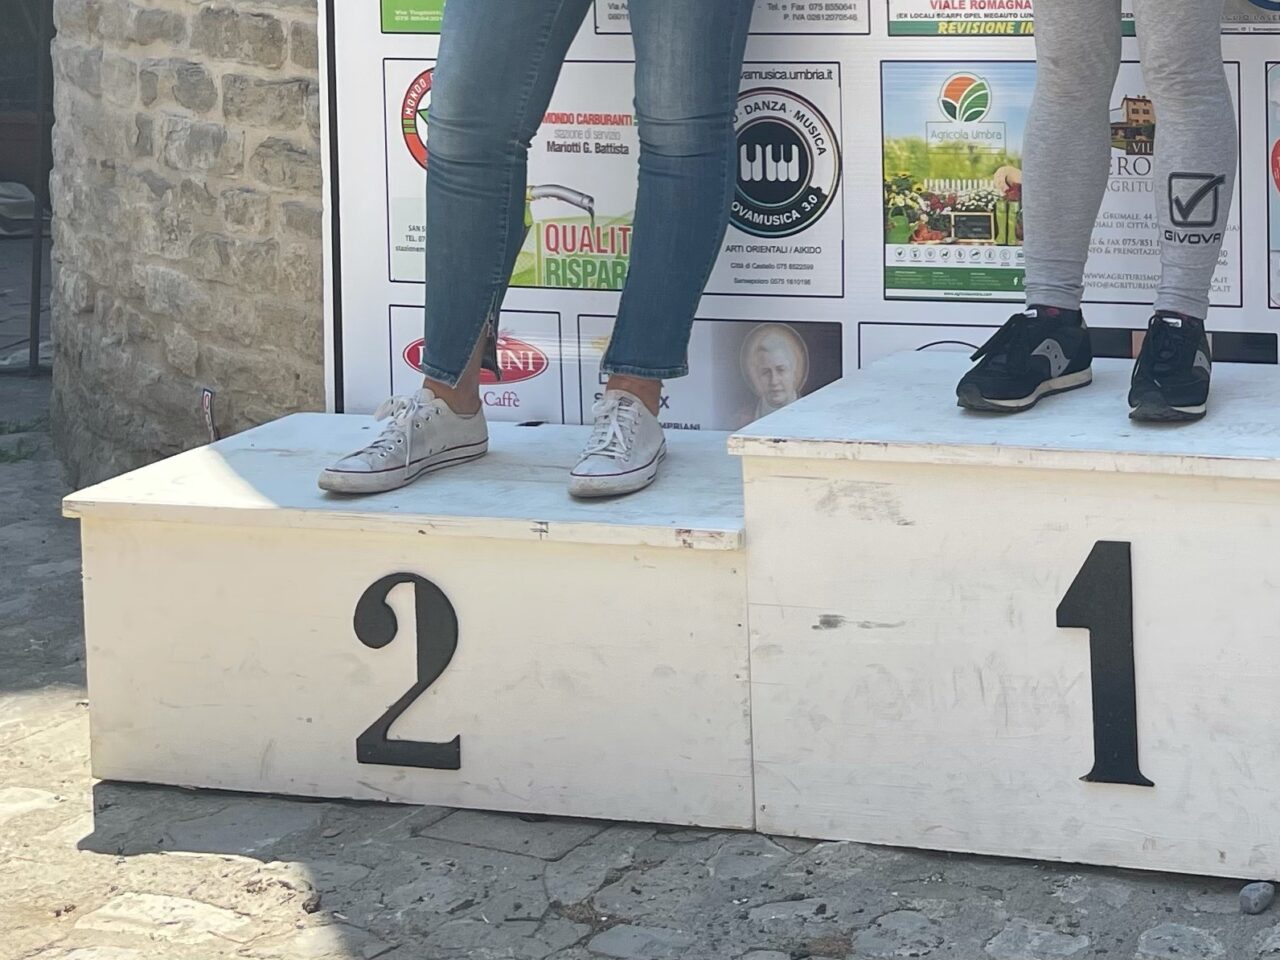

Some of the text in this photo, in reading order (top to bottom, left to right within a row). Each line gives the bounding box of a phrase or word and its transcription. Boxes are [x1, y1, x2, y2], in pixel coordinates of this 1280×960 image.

[930, 0, 1032, 10] VIALE ROMAGNA
[937, 21, 1016, 34] REVISIONE
[404, 78, 427, 116] MONDO
[577, 112, 632, 127] CARBURANTI
[743, 100, 828, 157] DANZA MUSICA
[930, 129, 1002, 144] Agricola Umbra
[546, 140, 630, 155] Mariotti G. Battista
[801, 193, 819, 212] 3.0
[1164, 229, 1222, 245] GIVOVA
[725, 244, 822, 255] ARTI ORIENTALI AIKIDO
[483, 390, 521, 408] Caffè
[353, 571, 461, 771] 2
[1055, 539, 1155, 788] 1
